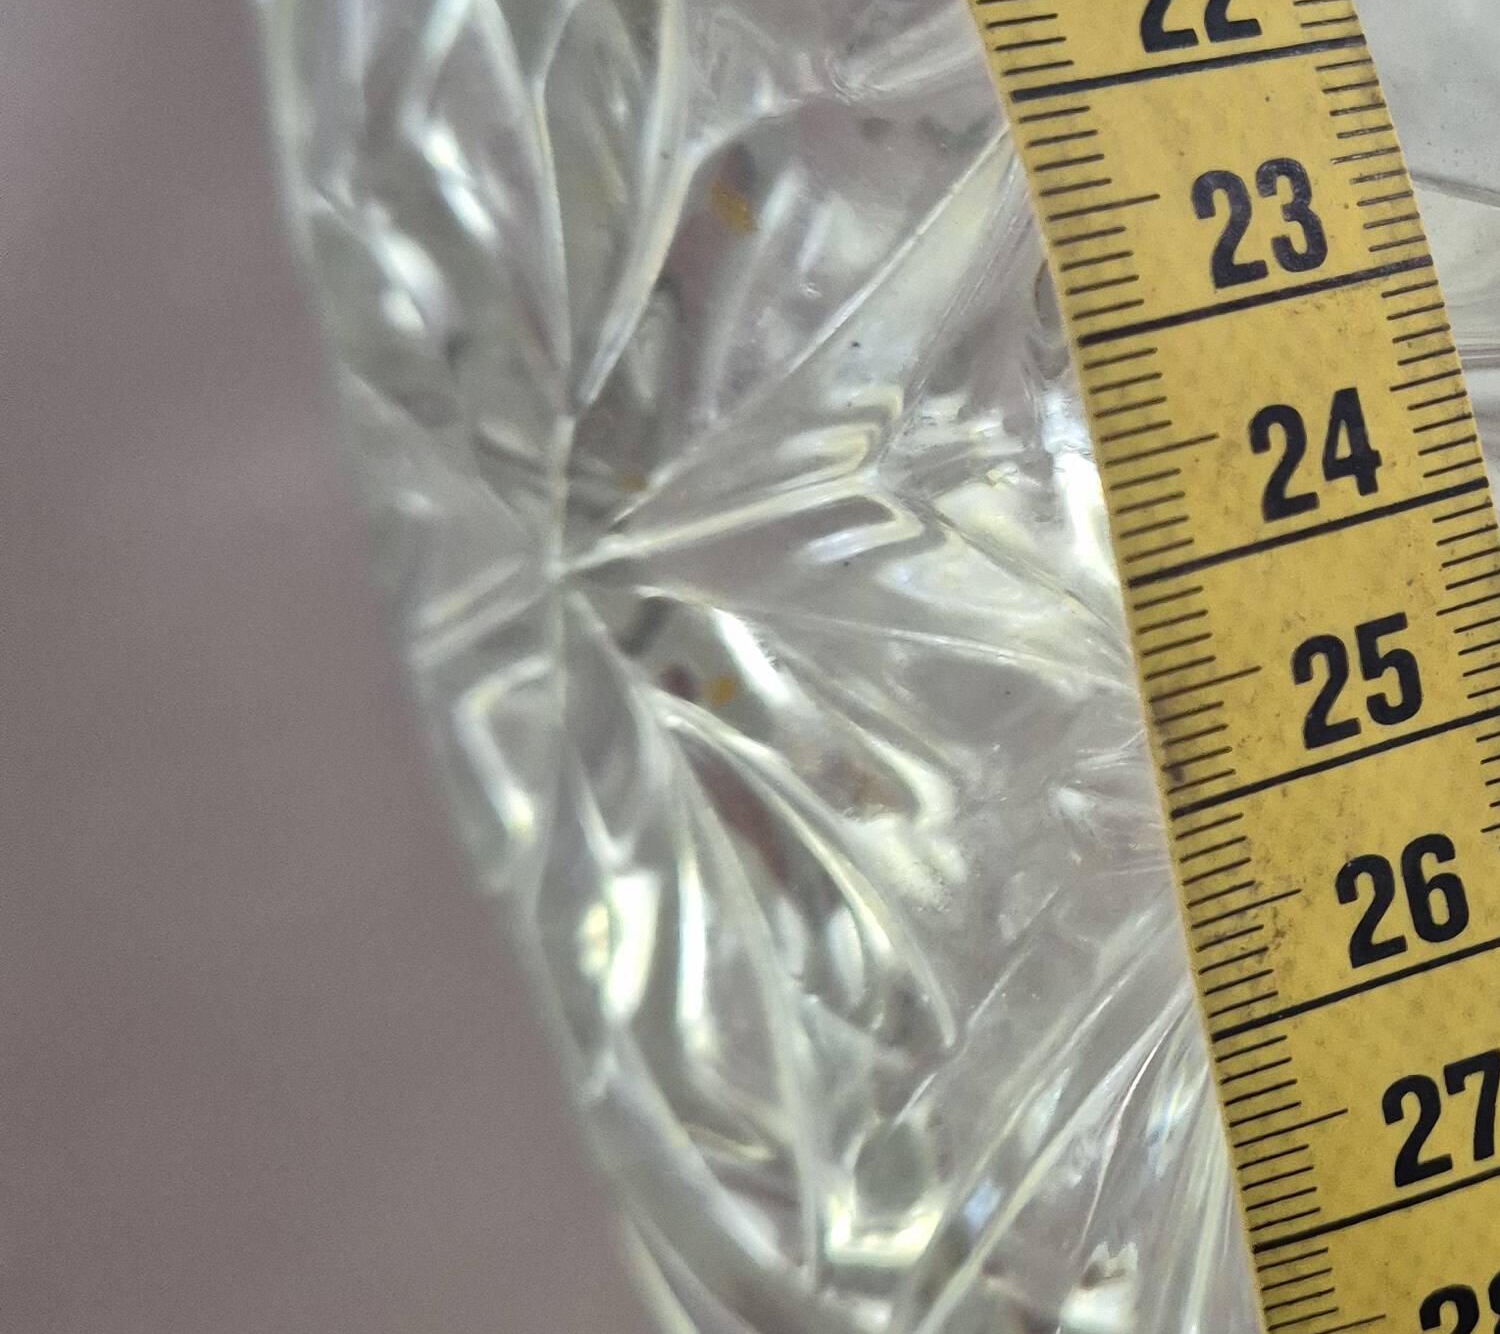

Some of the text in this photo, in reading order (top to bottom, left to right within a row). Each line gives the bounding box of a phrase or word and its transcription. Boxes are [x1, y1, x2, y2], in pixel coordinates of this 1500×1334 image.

[1191, 157, 1329, 290] 23
[1247, 386, 1383, 523] 24
[1291, 611, 1423, 751] 25
[1333, 832, 1471, 970] 26
